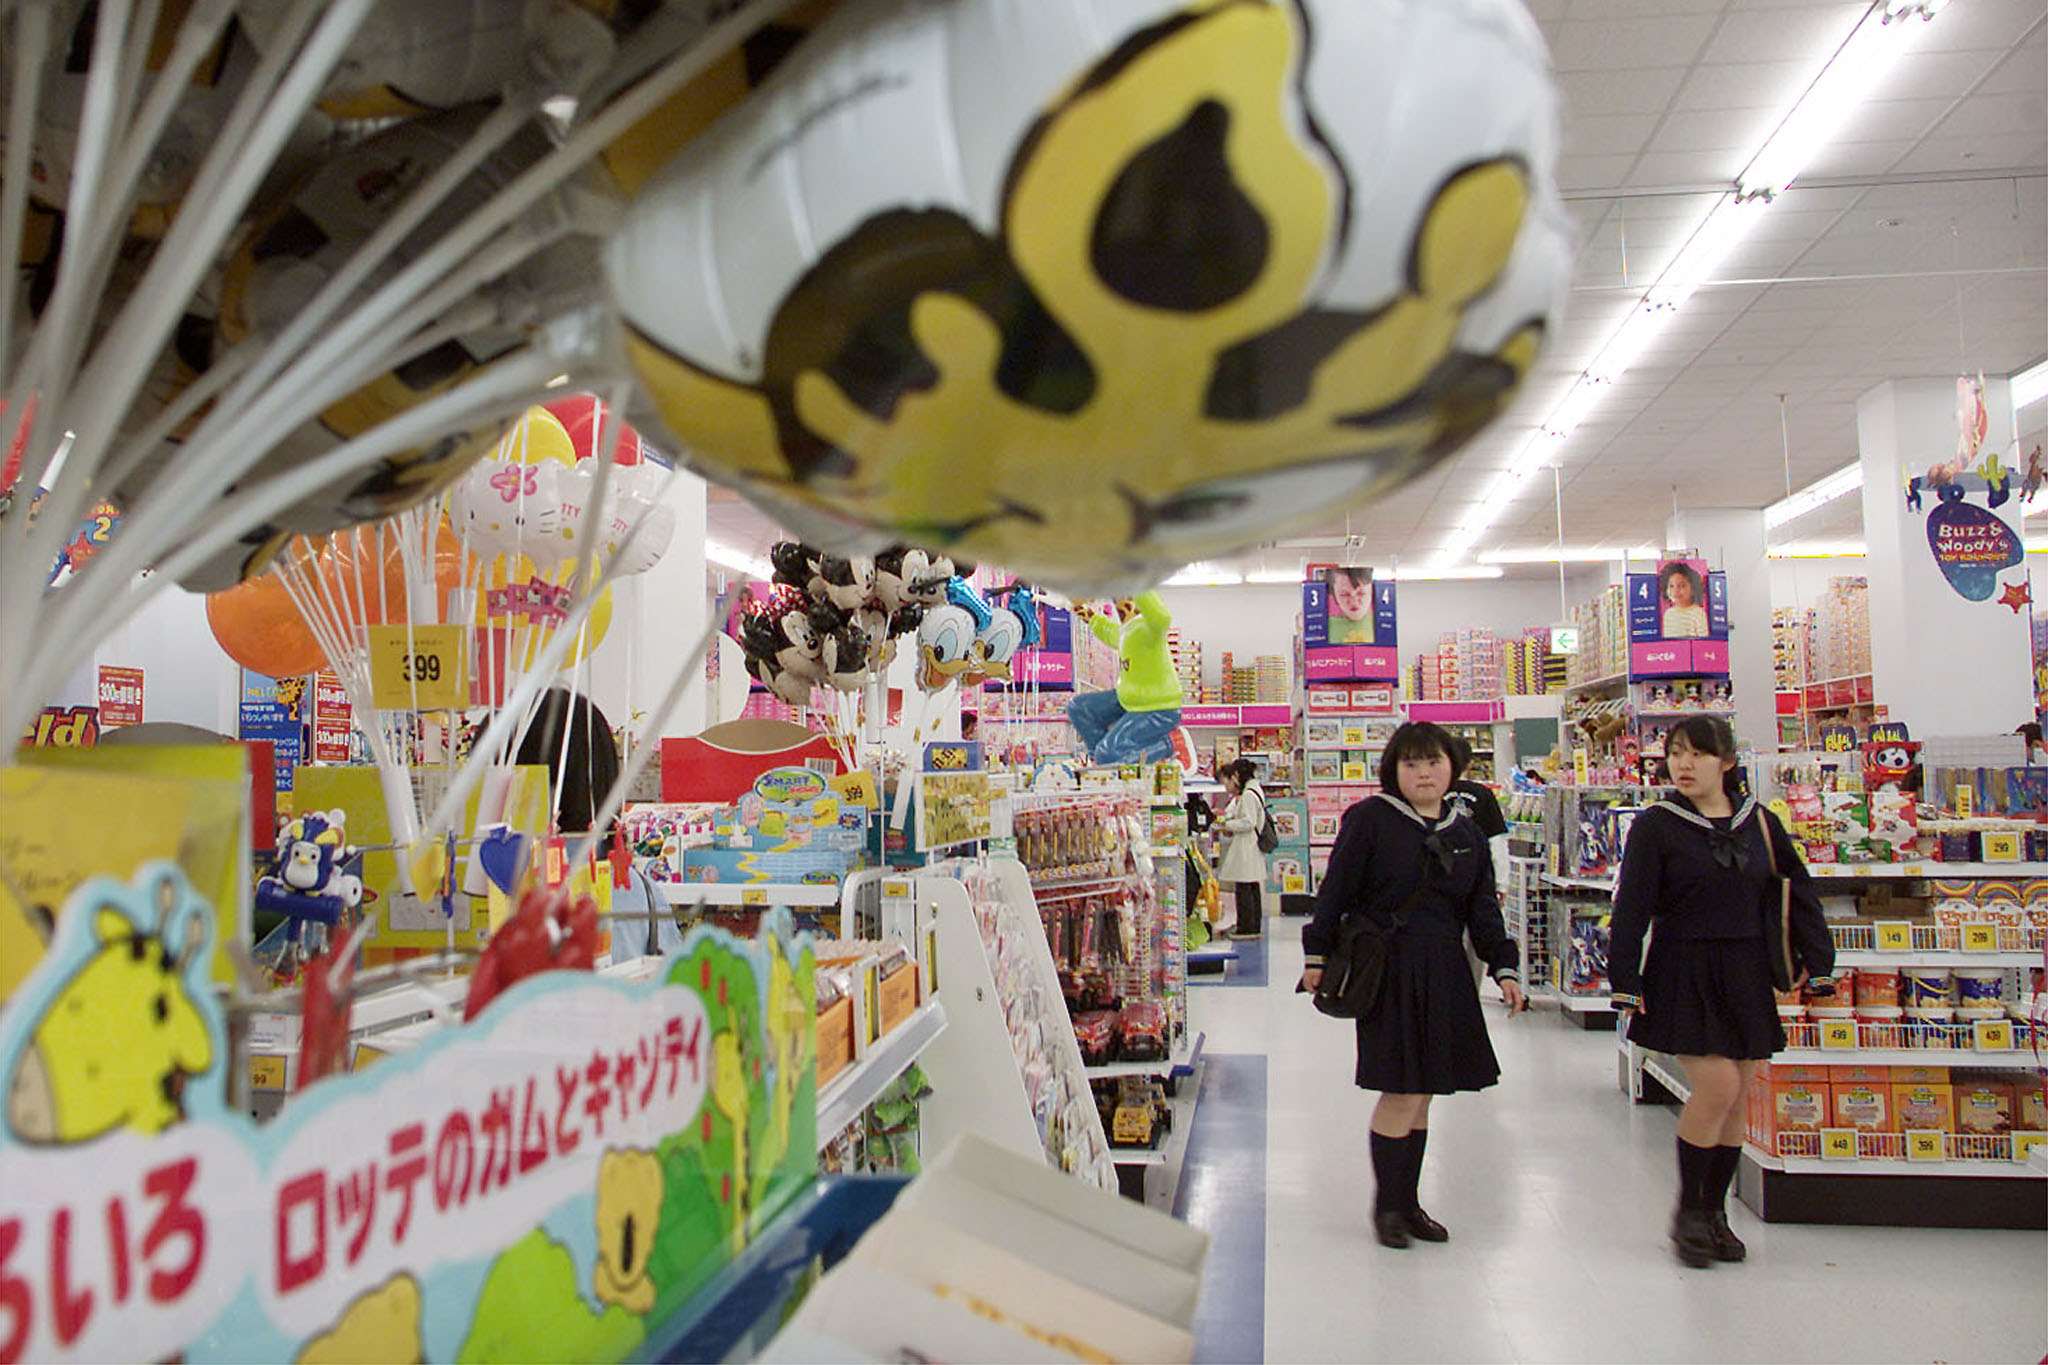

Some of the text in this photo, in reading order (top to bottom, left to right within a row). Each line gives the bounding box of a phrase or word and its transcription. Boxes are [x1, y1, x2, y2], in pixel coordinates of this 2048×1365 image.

[1939, 524, 1986, 537] Buzz
[1937, 539, 2009, 552] Woody's
[1310, 590, 1318, 606] 3
[1382, 588, 1389, 604] 4
[402, 654, 440, 682] 399
